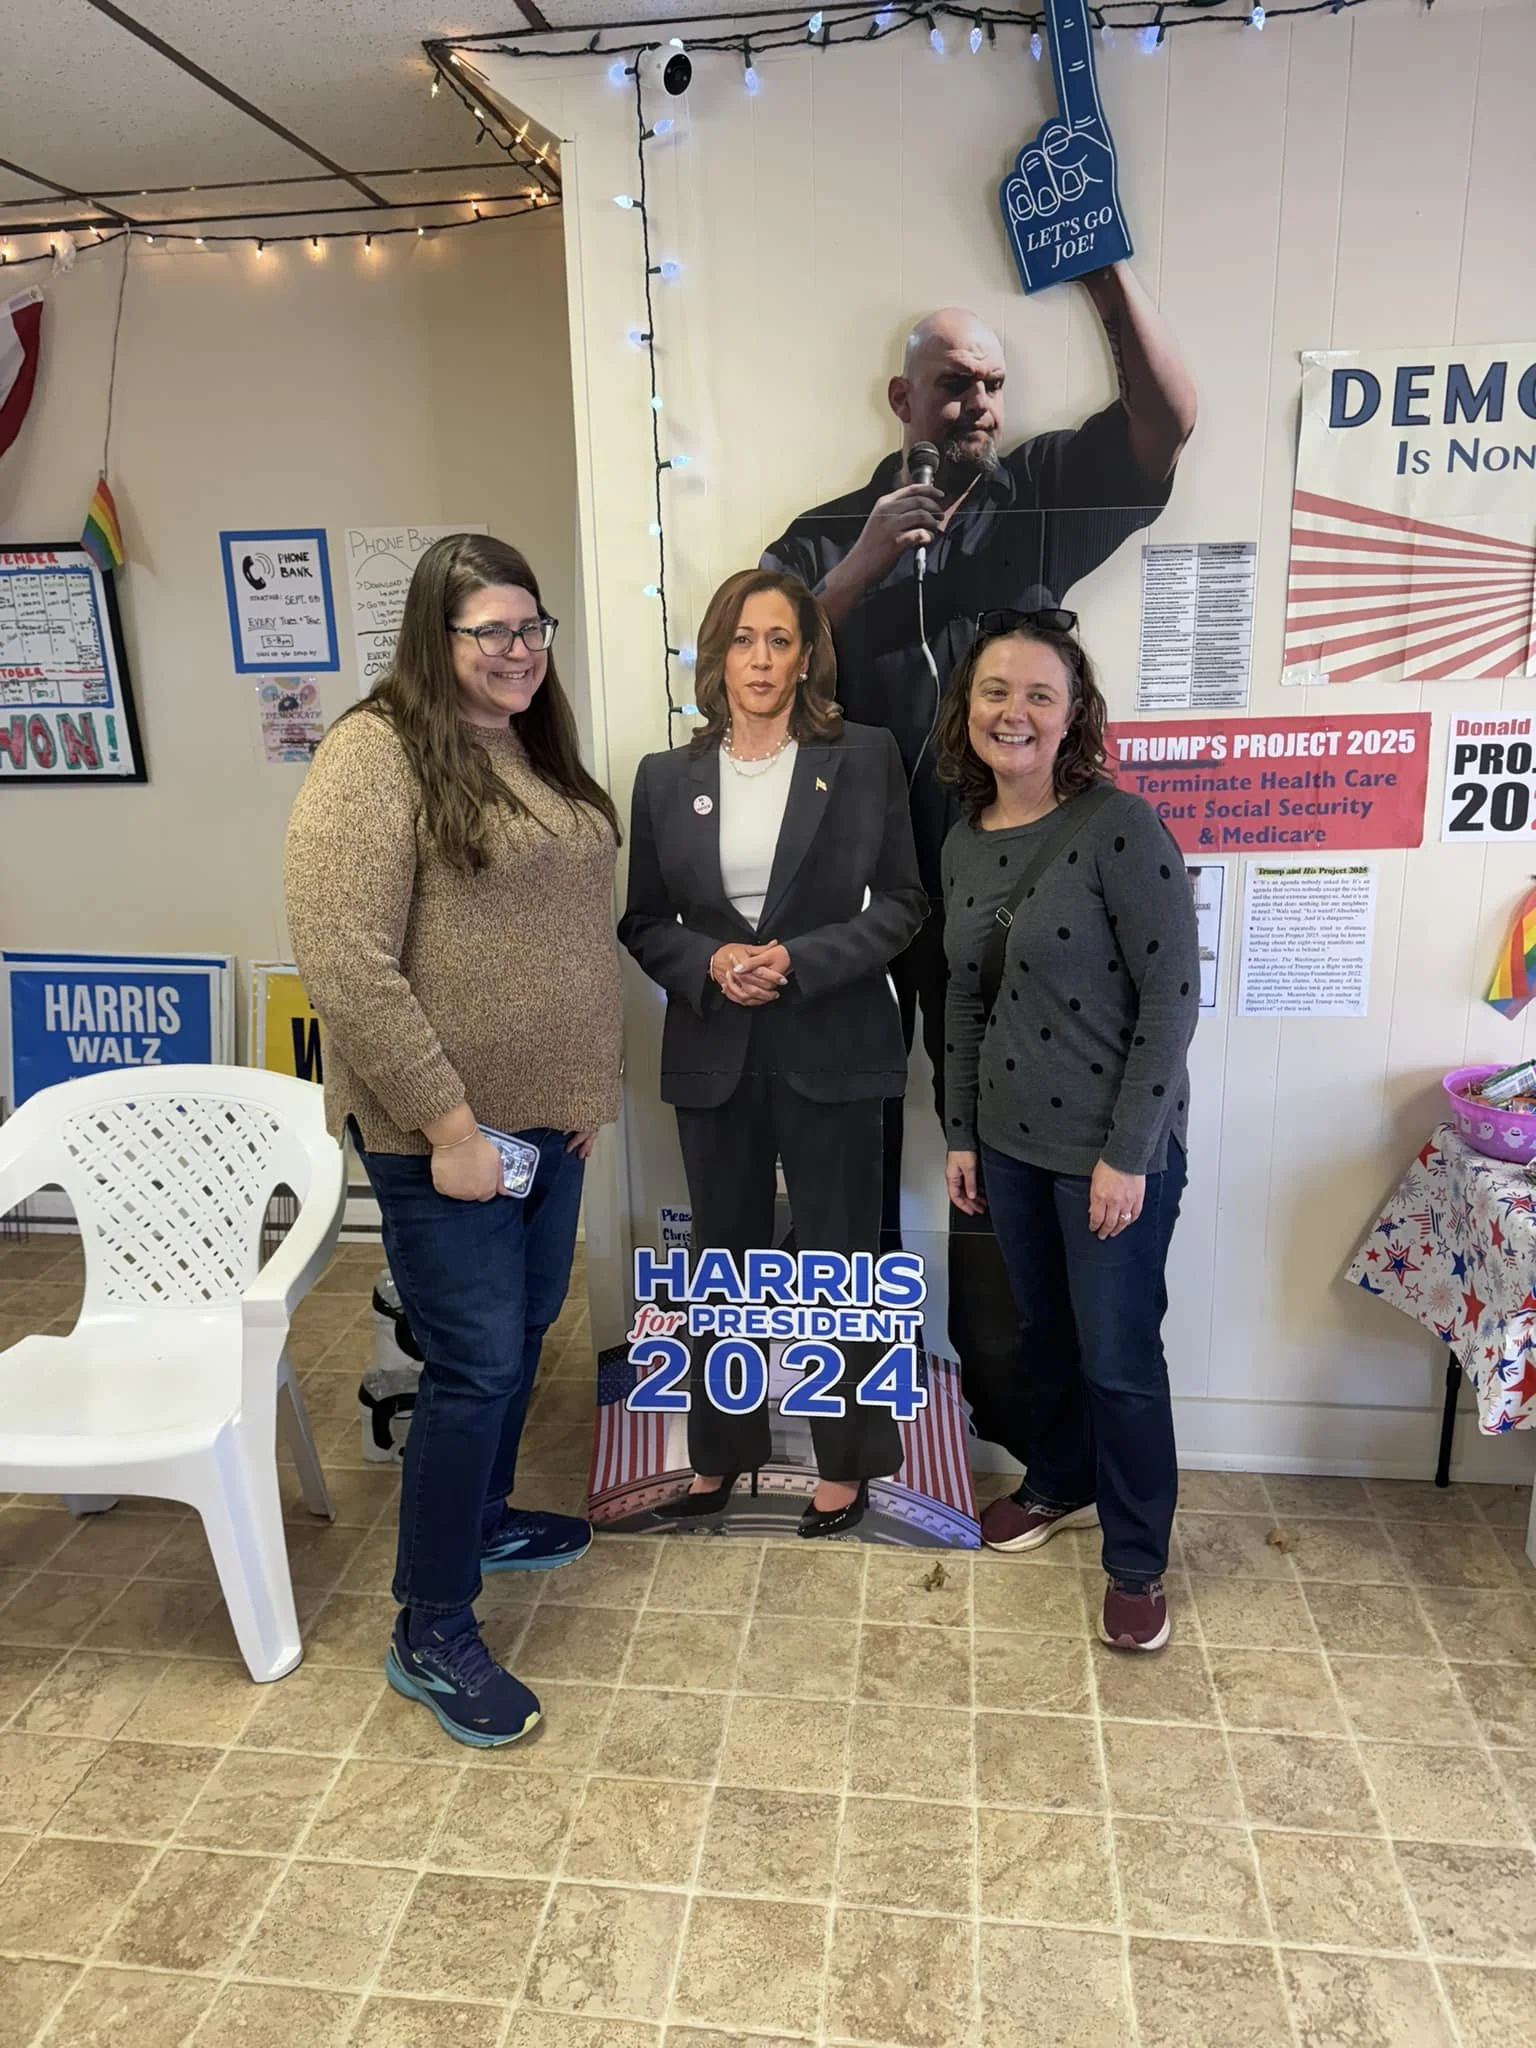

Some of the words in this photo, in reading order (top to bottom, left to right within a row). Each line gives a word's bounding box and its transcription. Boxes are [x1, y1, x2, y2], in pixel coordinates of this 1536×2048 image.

[1027, 217, 1080, 252] LET'S
[1084, 206, 1112, 230] GO
[1051, 233, 1095, 268] JOE!
[348, 529, 404, 558] PHONE
[407, 528, 446, 551] BAN
[277, 552, 310, 564] PHONE
[280, 566, 313, 578] BANK
[284, 594, 307, 605] SEPT.
[247, 617, 276, 628] EVERY
[373, 635, 398, 647] CAN
[1456, 718, 1532, 736] Donald
[1117, 734, 1227, 761] TRUMP'S
[1233, 731, 1342, 758] PROJECT
[1346, 729, 1416, 755] 2025
[1454, 742, 1536, 775] PRO
[1136, 774, 1252, 793] Terminate
[1261, 770, 1336, 790] Health
[1344, 769, 1397, 787] Care
[1156, 801, 1196, 819] Gut
[1204, 800, 1270, 819] Social
[1278, 797, 1374, 819] Security
[1449, 782, 1536, 832] 20
[1198, 827, 1215, 845] &
[1223, 825, 1327, 844] Medicare
[1258, 867, 1284, 876] Trump
[1287, 867, 1301, 875] and
[1303, 867, 1316, 875] His
[1319, 867, 1346, 876] Project
[1348, 866, 1368, 874] 2025
[44, 983, 182, 1036] HARRIS
[67, 1036, 162, 1065] WALZ
[635, 1248, 927, 1308] HARRIS
[627, 1303, 688, 1343] for
[688, 1304, 925, 1342] PRESIDENT
[627, 1337, 928, 1422] 2024
